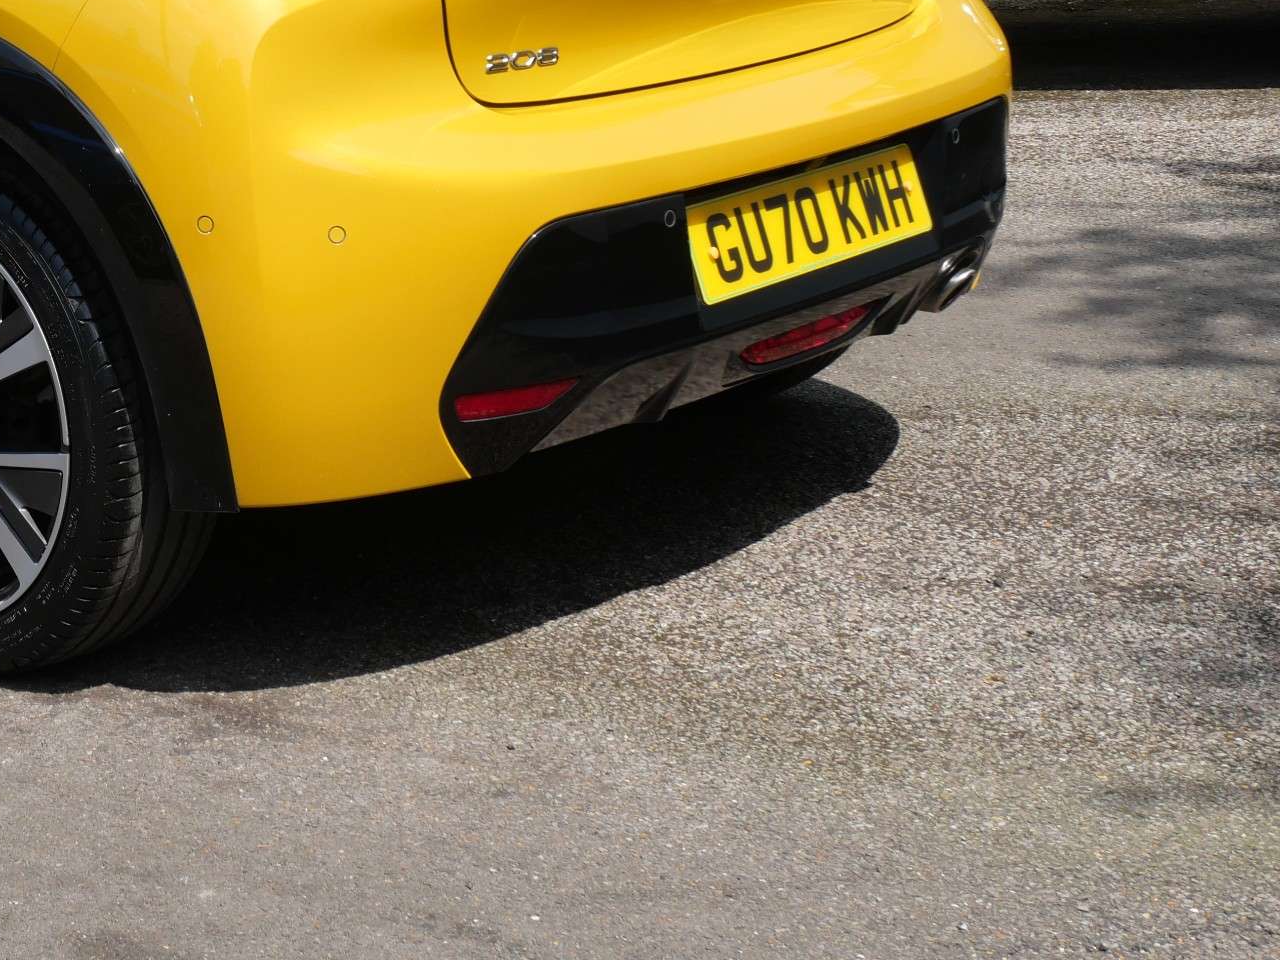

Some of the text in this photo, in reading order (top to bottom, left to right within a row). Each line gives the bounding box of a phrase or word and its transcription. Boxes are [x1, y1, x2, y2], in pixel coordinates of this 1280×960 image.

[486, 47, 559, 74] 208
[706, 160, 914, 283] GU70 KWH
